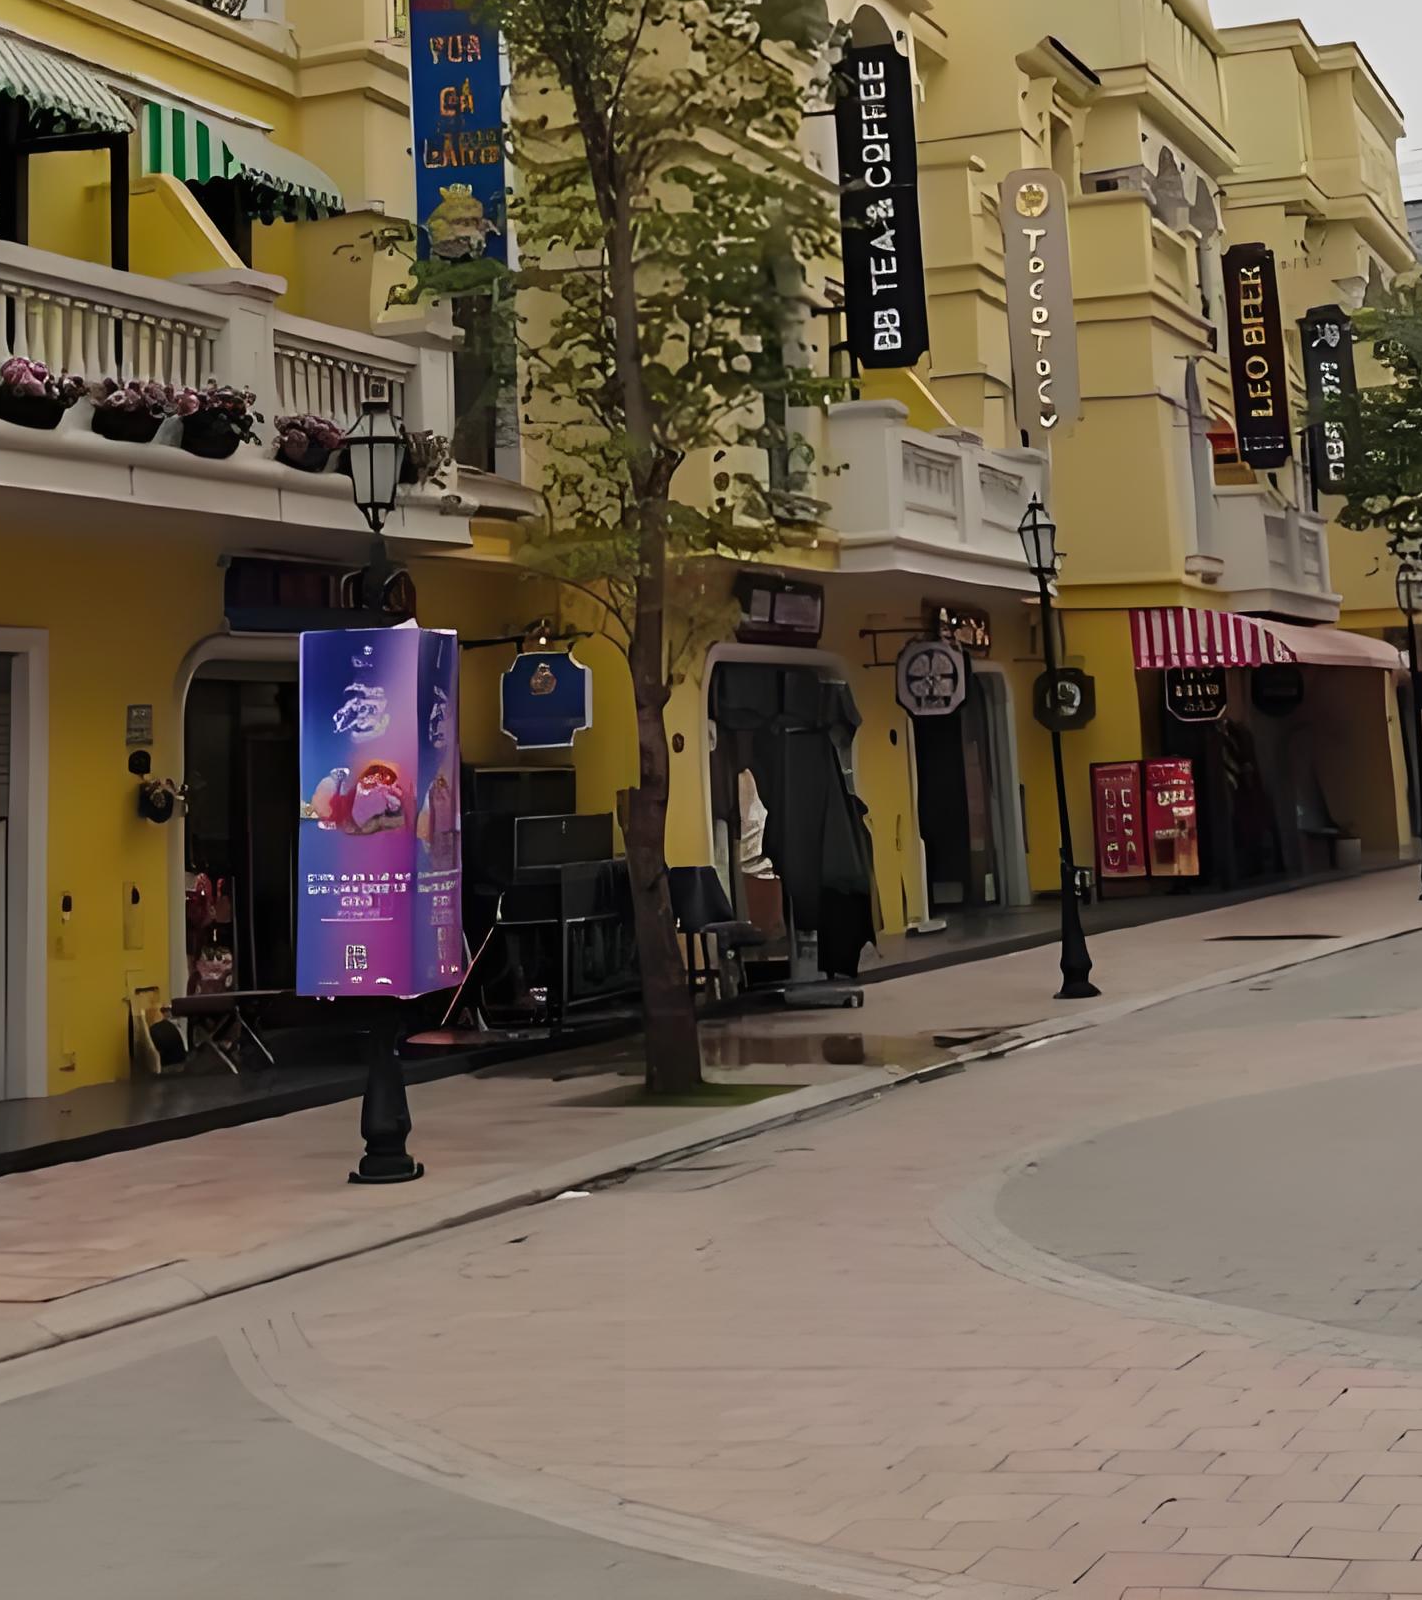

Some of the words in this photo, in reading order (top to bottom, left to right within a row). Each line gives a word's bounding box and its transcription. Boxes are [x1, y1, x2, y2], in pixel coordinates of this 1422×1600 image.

[858, 60, 893, 189] COFFEE
[869, 229, 898, 296] TEA
[873, 307, 903, 350] BB
[1245, 355, 1275, 418] LEO
